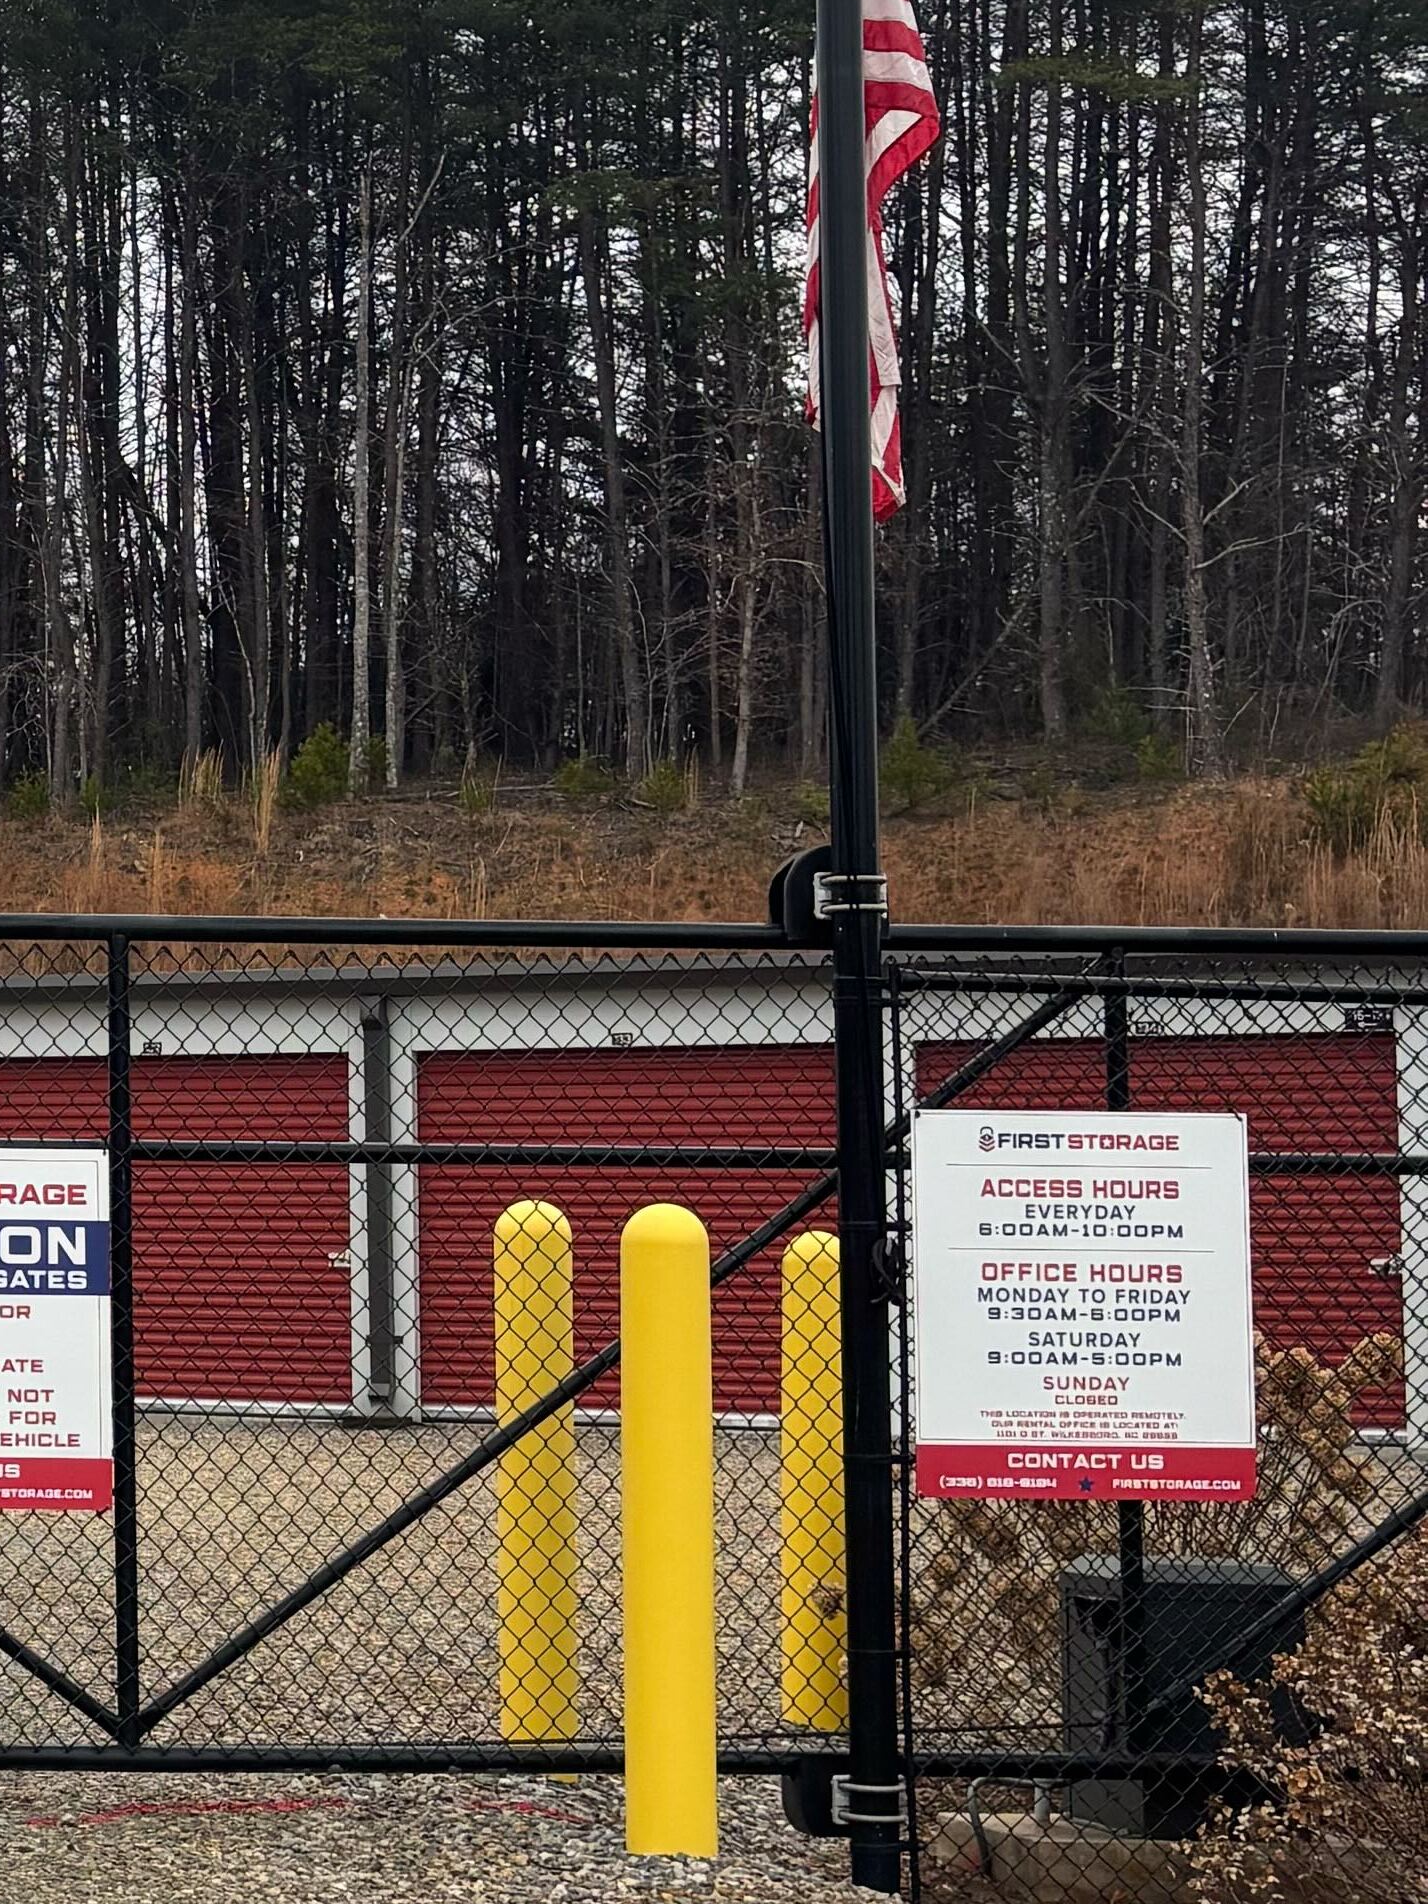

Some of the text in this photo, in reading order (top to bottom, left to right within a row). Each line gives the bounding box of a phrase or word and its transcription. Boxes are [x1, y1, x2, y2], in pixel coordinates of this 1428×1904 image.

[981, 1179, 1179, 1199] ACCESS HOURS
[1026, 1204, 1135, 1220] EVERYDAY
[980, 1223, 1183, 1237] 6:00AM-10:00PM
[982, 1263, 1182, 1283] OFFICE HOURS
[978, 1288, 1190, 1304] MONDAY TO FRIDAY
[1029, 1332, 1140, 1347] SATURDAY
[1044, 1376, 1129, 1390] SUNDAY
[8, 1389, 54, 1402] NOT
[1055, 1395, 1118, 1405] CLOSED
[10, 1411, 56, 1425] FOR
[1006, 1410, 1056, 1418] LOCATION
[1073, 1411, 1128, 1419] OPERATED
[1017, 1420, 1055, 1428] RENTAL
[1059, 1420, 1095, 1429] OFFICE
[1113, 1421, 1160, 1429] LOCATED
[1008, 1454, 1163, 1469] CONTACT US
[1113, 1479, 1240, 1489] FIRSTSTORAGE.COM
